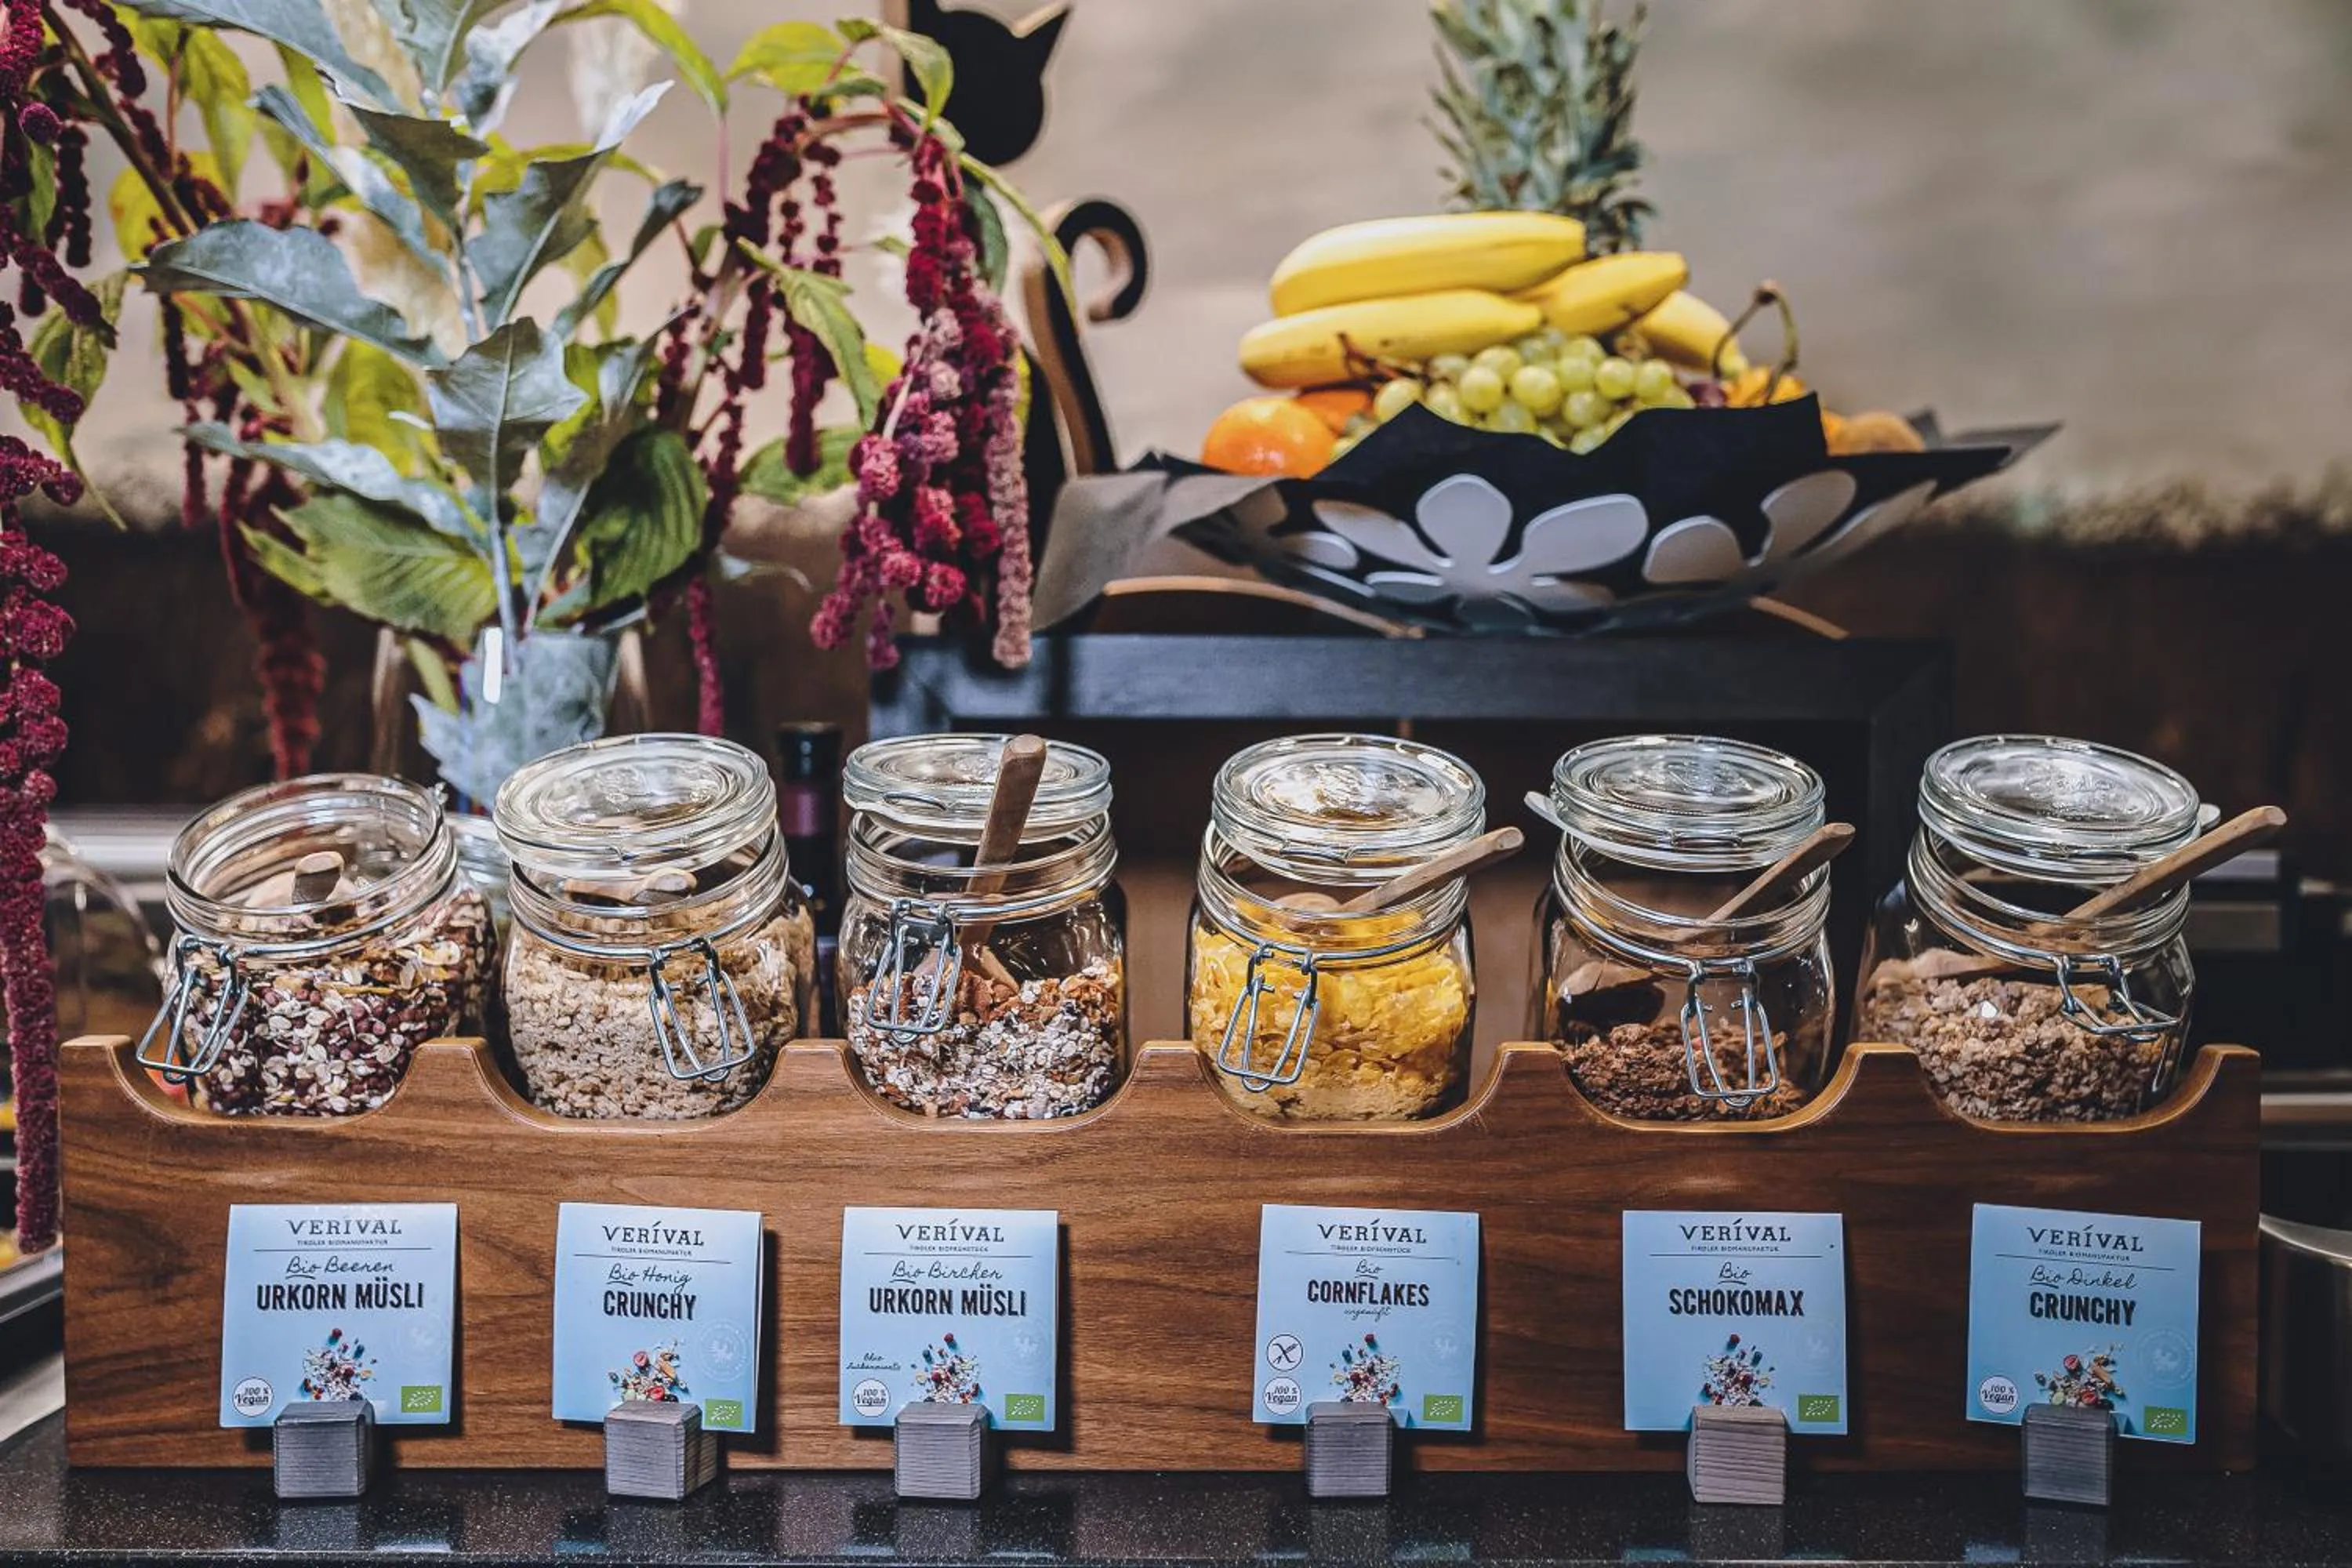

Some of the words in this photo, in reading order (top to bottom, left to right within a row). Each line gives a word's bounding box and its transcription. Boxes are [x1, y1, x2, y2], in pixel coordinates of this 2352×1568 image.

[602, 1221, 704, 1246] VERÍVAL
[895, 1218, 1004, 1242] VERÍVAL
[1318, 1218, 1426, 1243] VERÍVAL
[1679, 1218, 1791, 1242] VERÍVAL
[2027, 1224, 2143, 1252] VERÍVAL
[286, 1256, 322, 1274] Bio
[324, 1256, 395, 1273] Beeren
[891, 1260, 924, 1278] Bio
[927, 1261, 1003, 1279] Bircher
[1356, 1259, 1384, 1274] Bio
[1719, 1261, 1752, 1279] Bio
[2031, 1265, 2063, 1283] Bio
[2067, 1268, 2138, 1290] Dinkel
[608, 1263, 639, 1281] Bio
[642, 1265, 692, 1293] Honig
[257, 1283, 347, 1310] URKORN
[355, 1276, 424, 1309] MÜSLI
[603, 1290, 697, 1321] CRUNCHY
[869, 1287, 953, 1316] URKORN
[961, 1283, 1026, 1316] MÜSLI
[1308, 1279, 1430, 1307] CORNFLAKES
[1669, 1288, 1805, 1317] SCHOKOMAX
[2030, 1291, 2136, 1327] CRUNCHY
[234, 1392, 269, 1405] Vegan
[854, 1395, 887, 1406] Vegan
[1265, 1392, 1298, 1404] Vegan
[1982, 1391, 2014, 1403] Vegan
